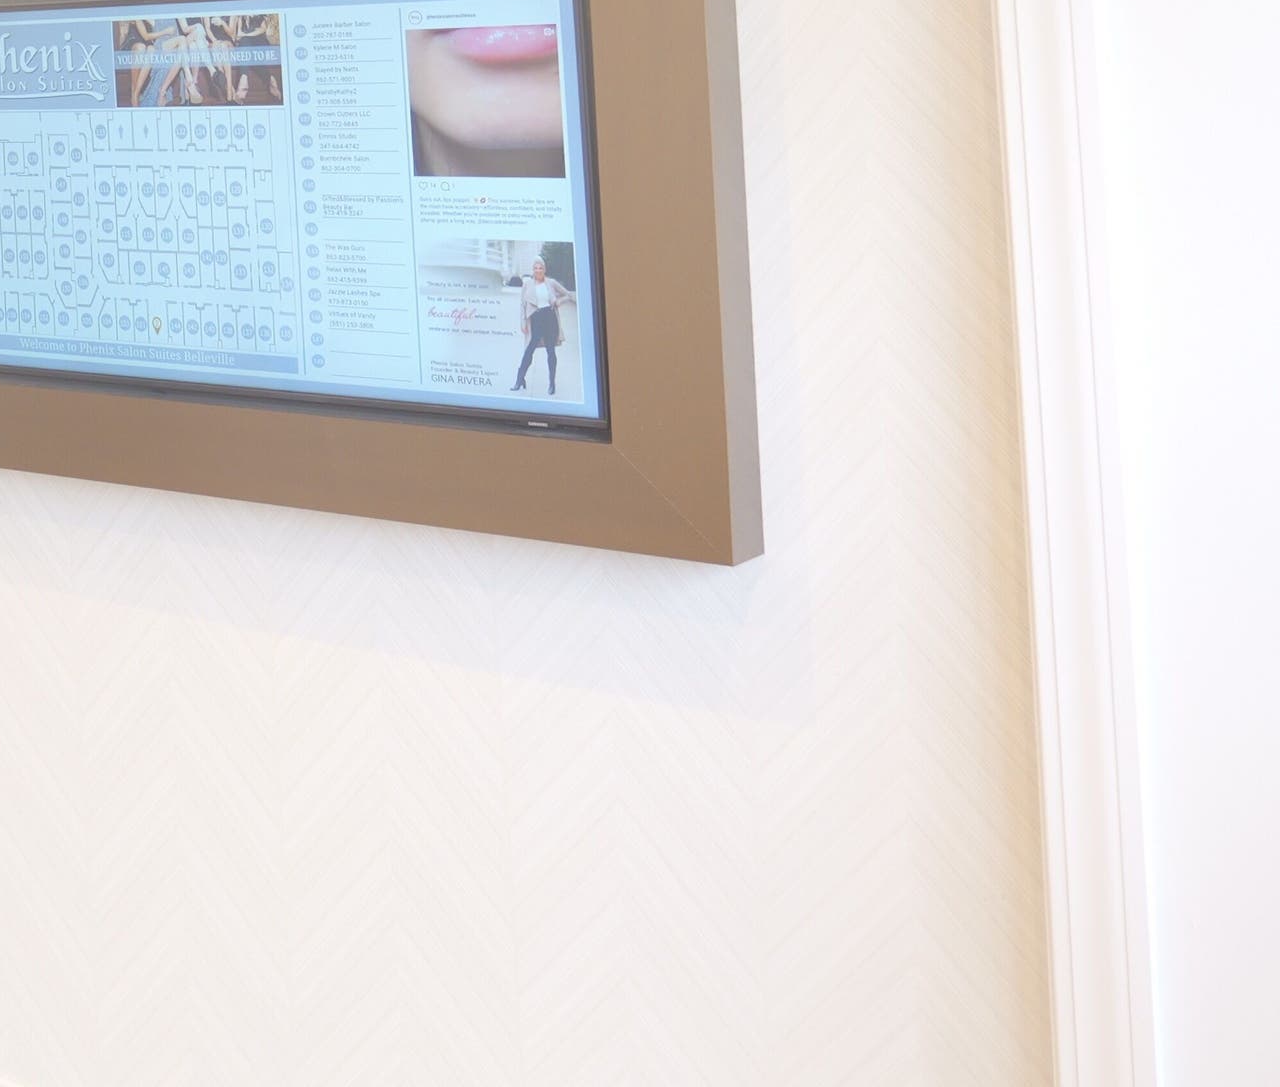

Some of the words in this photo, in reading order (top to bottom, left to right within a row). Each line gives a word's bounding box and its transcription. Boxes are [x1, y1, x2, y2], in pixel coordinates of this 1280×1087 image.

[117, 55, 133, 65] YOU
[134, 55, 150, 64] ARE
[212, 52, 228, 63] YOU
[231, 51, 250, 62] NEED
[253, 51, 264, 61] TO
[428, 306, 477, 326] beautiful
[19, 338, 65, 351] Welcome
[67, 342, 77, 352] to
[80, 342, 114, 356] Phenix
[117, 346, 146, 359] Salon
[149, 349, 181, 361] Suites
[184, 352, 235, 366] Belleville
[431, 374, 454, 383] GINA
[457, 376, 492, 386] RIVERA
